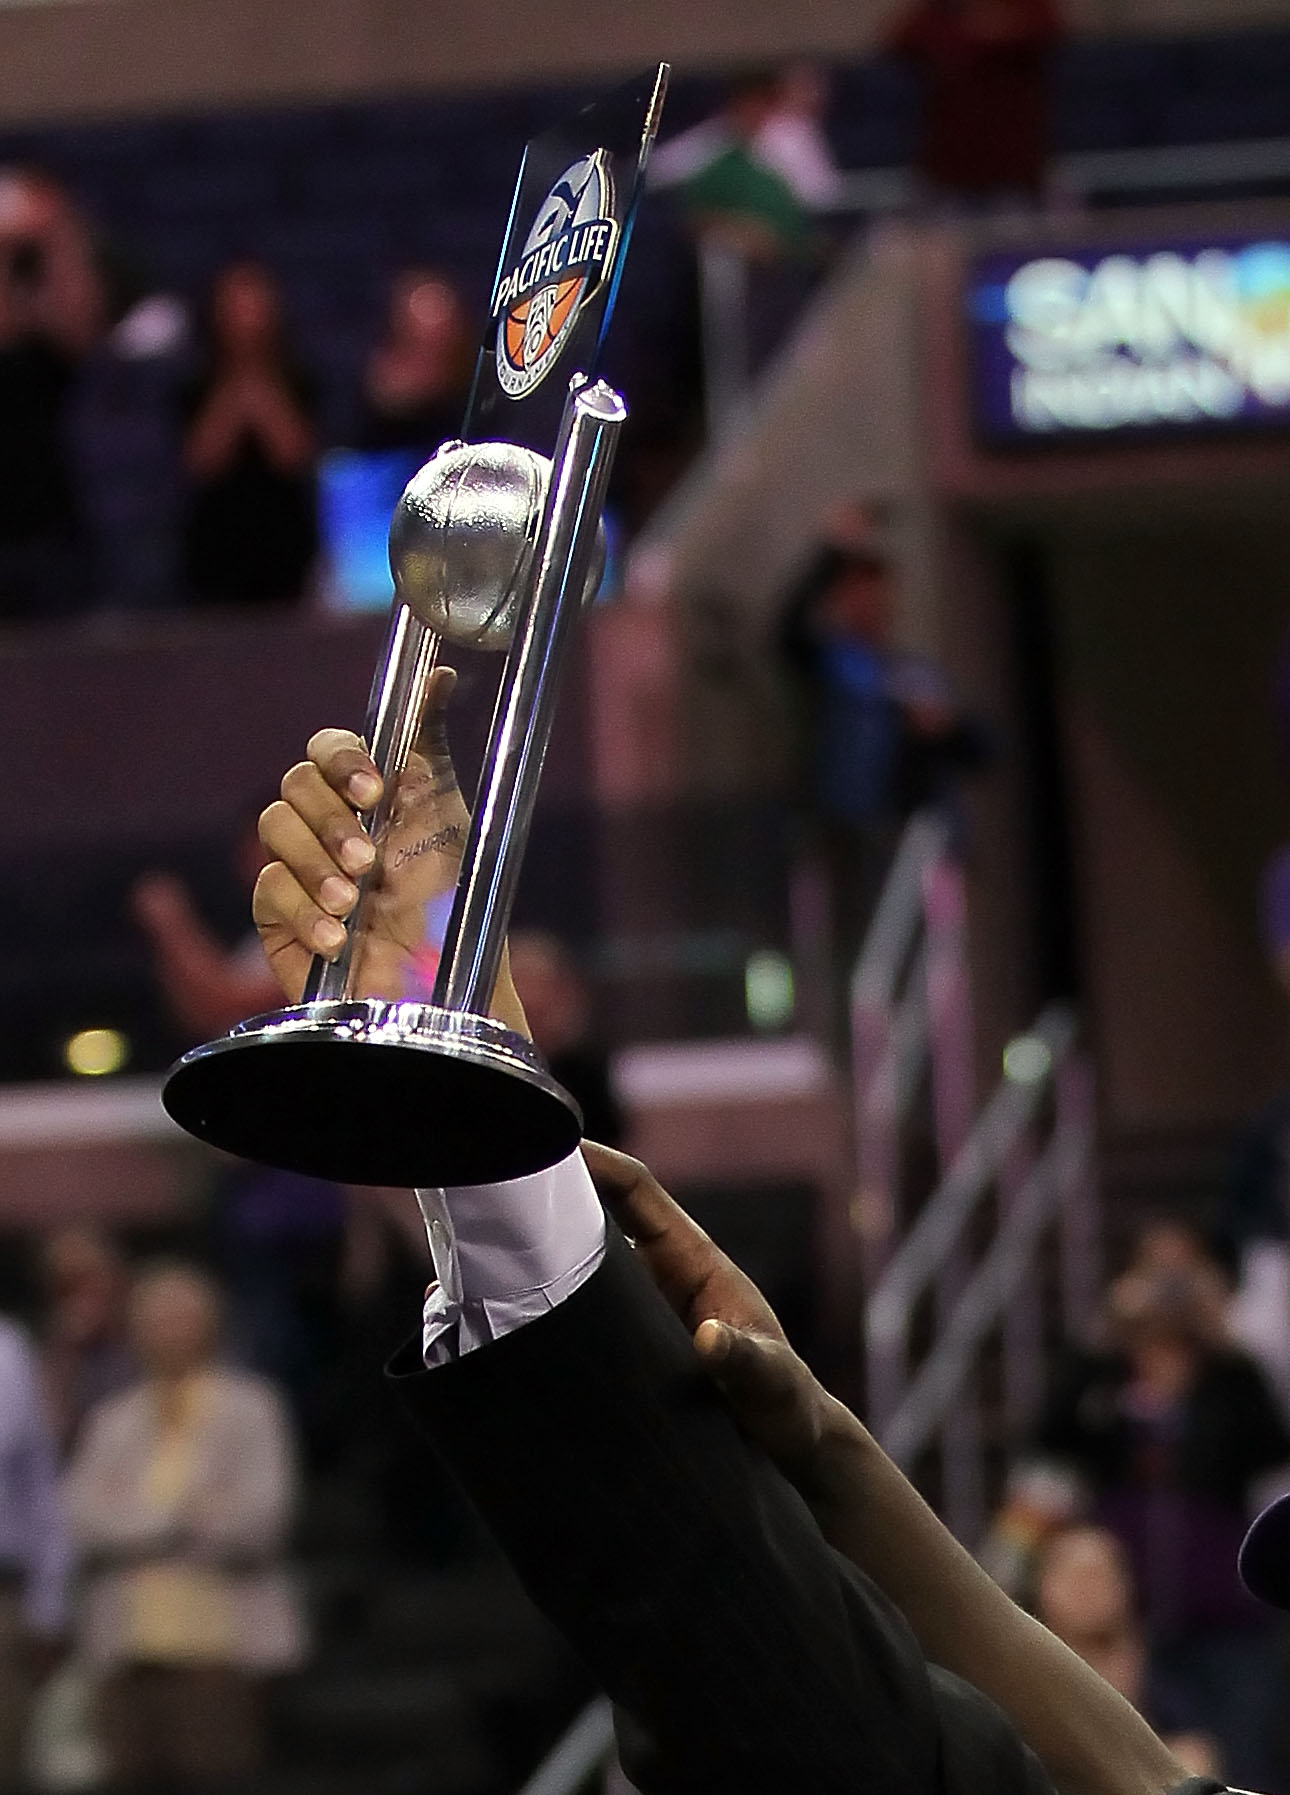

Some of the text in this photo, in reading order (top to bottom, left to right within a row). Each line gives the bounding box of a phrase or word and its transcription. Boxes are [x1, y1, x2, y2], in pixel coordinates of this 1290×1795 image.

[492, 224, 609, 317] PACIFIC LIFE
[1004, 252, 1246, 370] SAN
